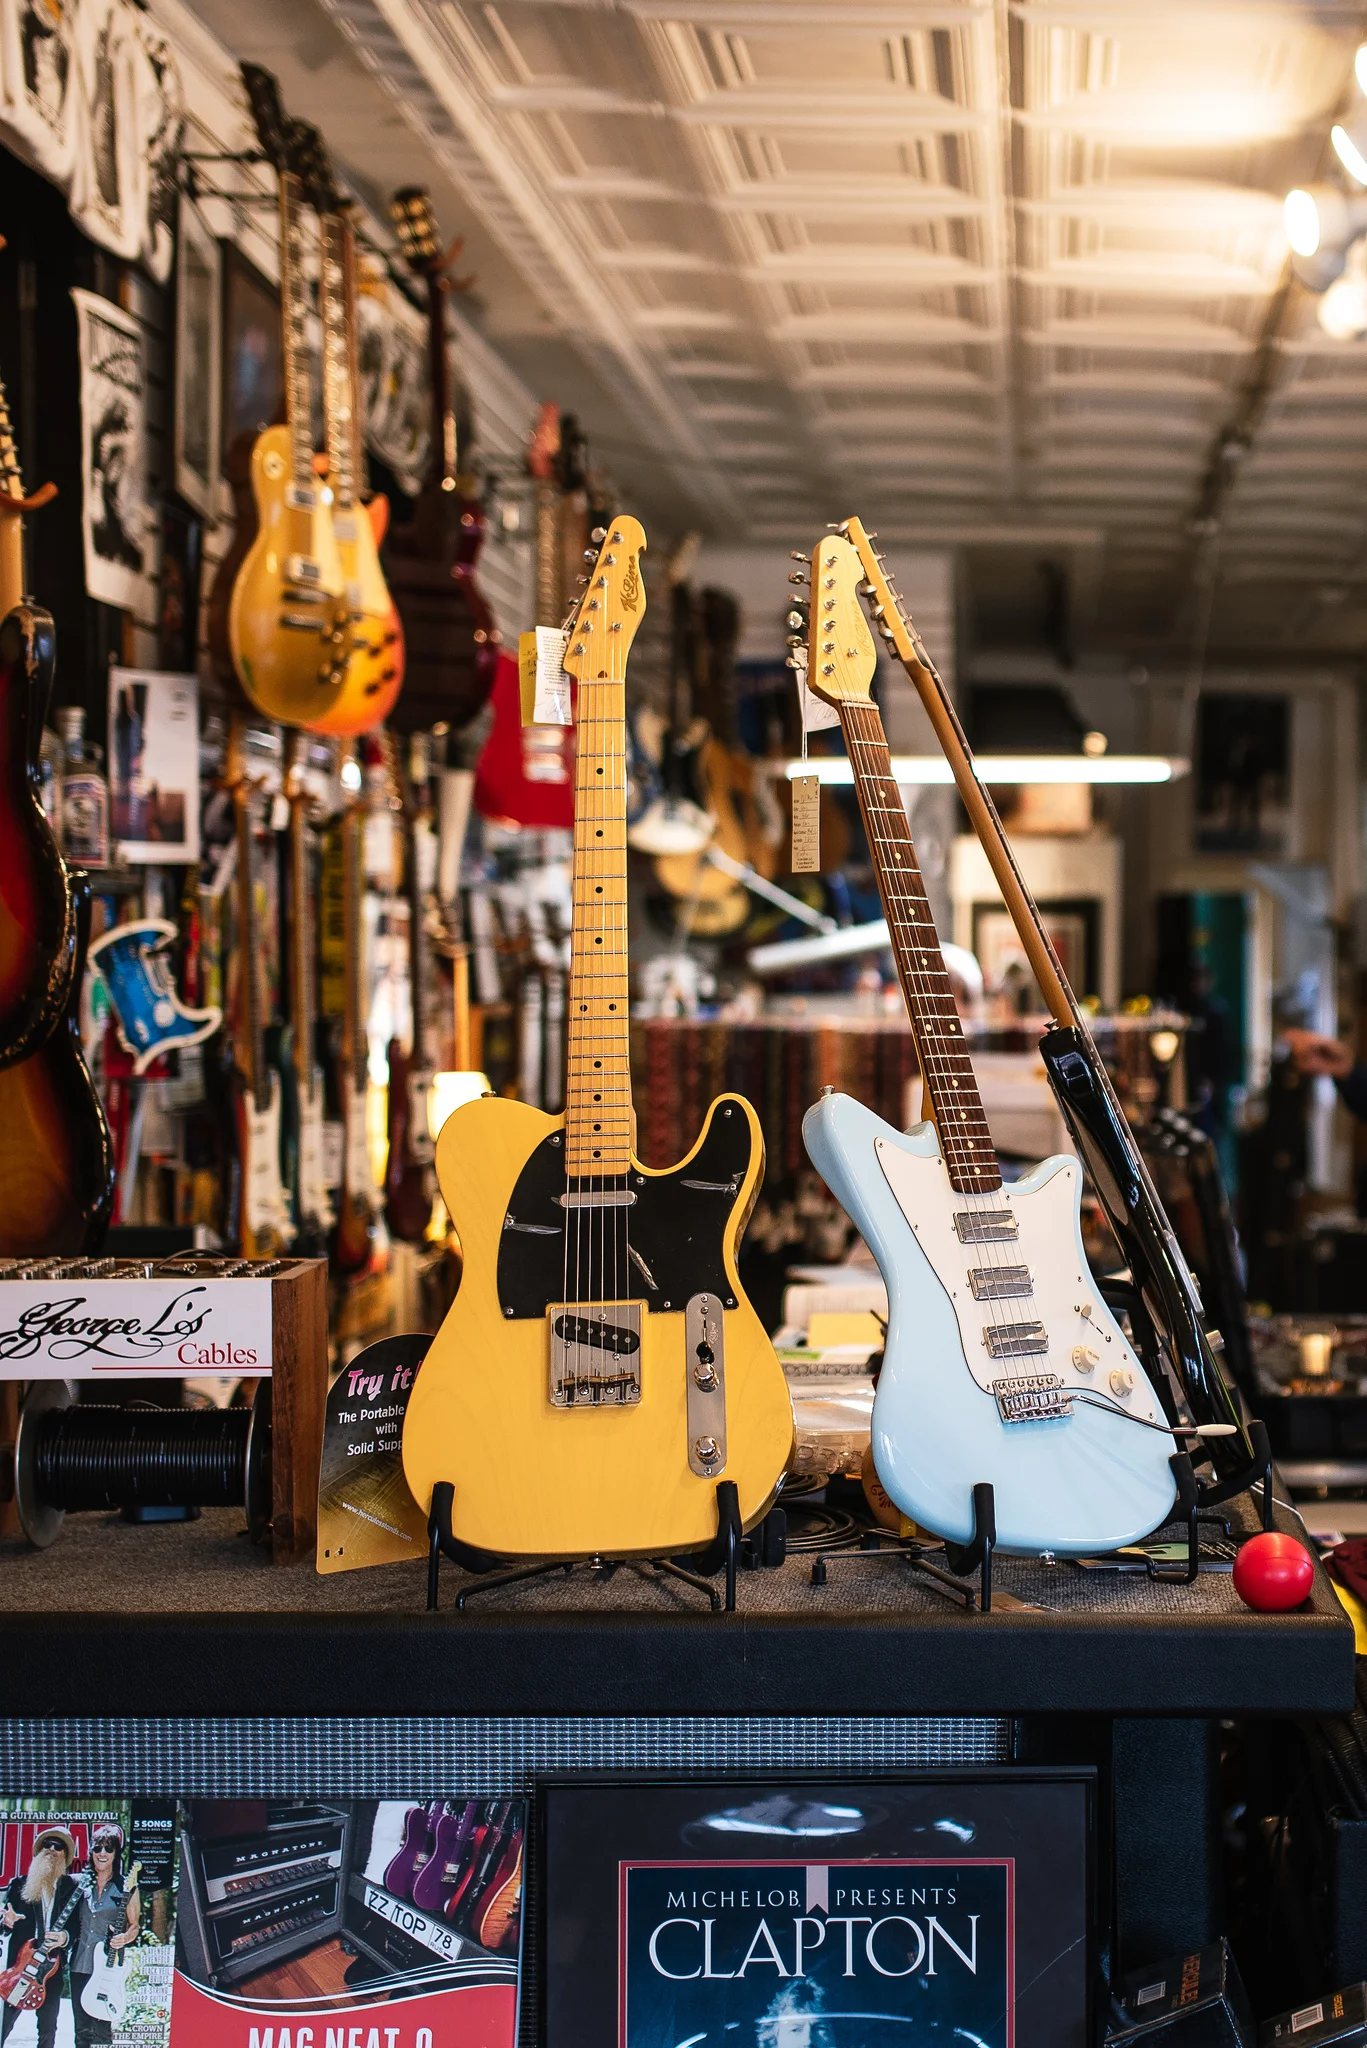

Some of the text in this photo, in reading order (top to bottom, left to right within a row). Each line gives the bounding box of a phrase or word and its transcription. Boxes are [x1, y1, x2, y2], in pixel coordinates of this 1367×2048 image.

[0, 1296, 142, 1360] George
[178, 1342, 258, 1365] Cables
[347, 1368, 384, 1402] Try
[338, 1404, 405, 1425] The Portable
[375, 1422, 398, 1436] with
[347, 1440, 375, 1456] Solid
[342, 1500, 413, 1543] www.herculesstands.com
[10, 1812, 46, 1820] GUITAR
[236, 1840, 323, 1862] MAGNATONE
[242, 1894, 320, 1924] MAGNATONE
[667, 1888, 957, 1908] MICHELOB PRESENTS
[368, 1890, 452, 1949] ZZ TOP 78
[648, 1915, 980, 1980] CLAPTON
[249, 2028, 314, 2048] MAG
